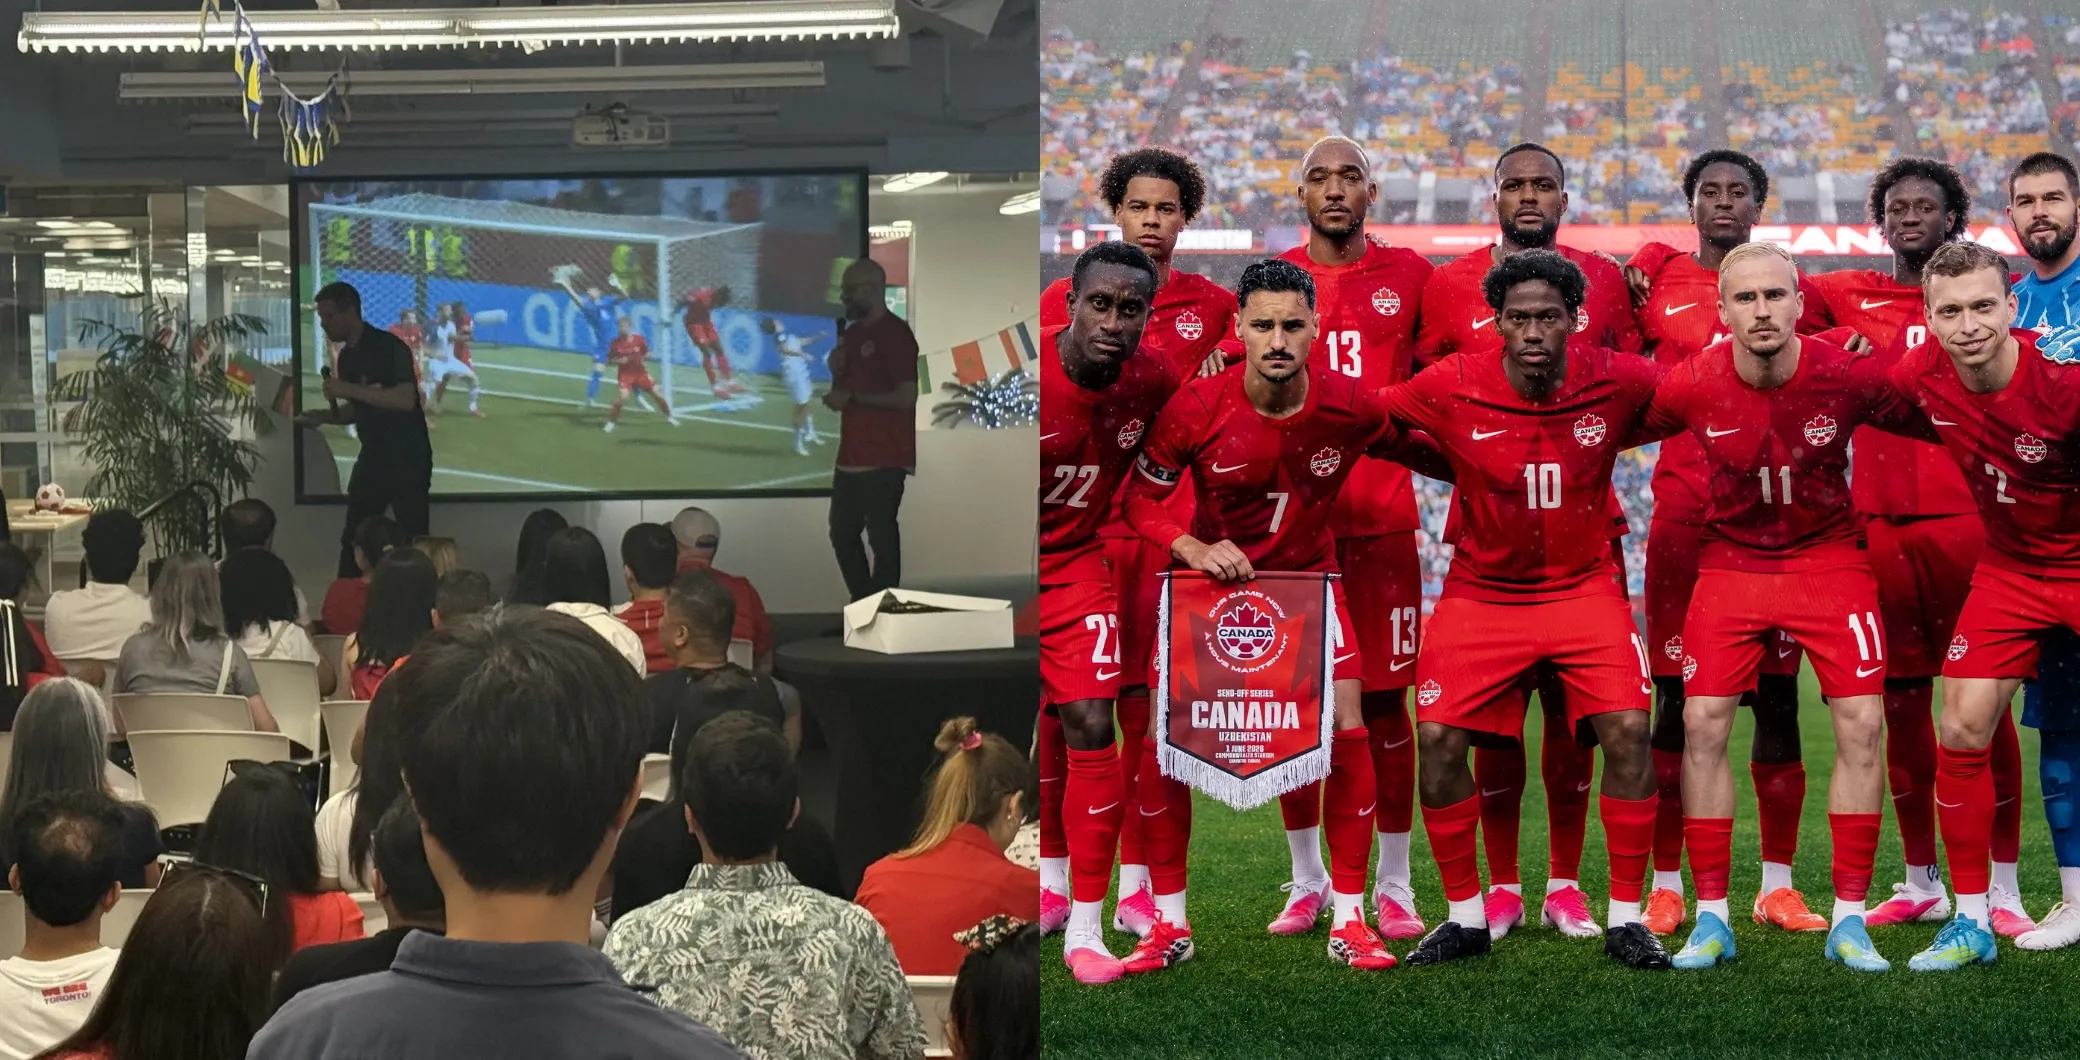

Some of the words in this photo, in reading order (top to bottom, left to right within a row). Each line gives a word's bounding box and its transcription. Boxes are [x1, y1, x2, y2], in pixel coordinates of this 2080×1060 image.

[1749, 225, 2022, 255] CANA
[1326, 330, 1362, 378] 13
[1574, 425, 1606, 436] CANADA
[1805, 426, 1837, 436] CANADA
[1311, 457, 1340, 468] CANADA
[2015, 444, 2047, 453] CANADA
[1043, 465, 1100, 508] 22
[1523, 463, 1562, 510] 10
[1758, 465, 1793, 505] 11
[1984, 463, 2017, 504] 2
[1267, 492, 1289, 534] 7
[1209, 597, 1228, 618] OUR
[1229, 590, 1264, 599] GAME
[1265, 596, 1286, 619] NOW
[1218, 629, 1275, 638] CANADA
[1390, 606, 1416, 656] 13
[1849, 611, 1883, 661] 11
[1207, 642, 1230, 668] NOUS
[1231, 633, 1289, 673] MAINTENANT
[1217, 689, 1249, 698] SEND-OFF
[1250, 689, 1274, 698] SERIES
[1191, 701, 1300, 730] CANADA
[1218, 732, 1272, 742] UZBEKISTAN
[1231, 744, 1246, 753] JUNE
[41, 986, 60, 997] WE
